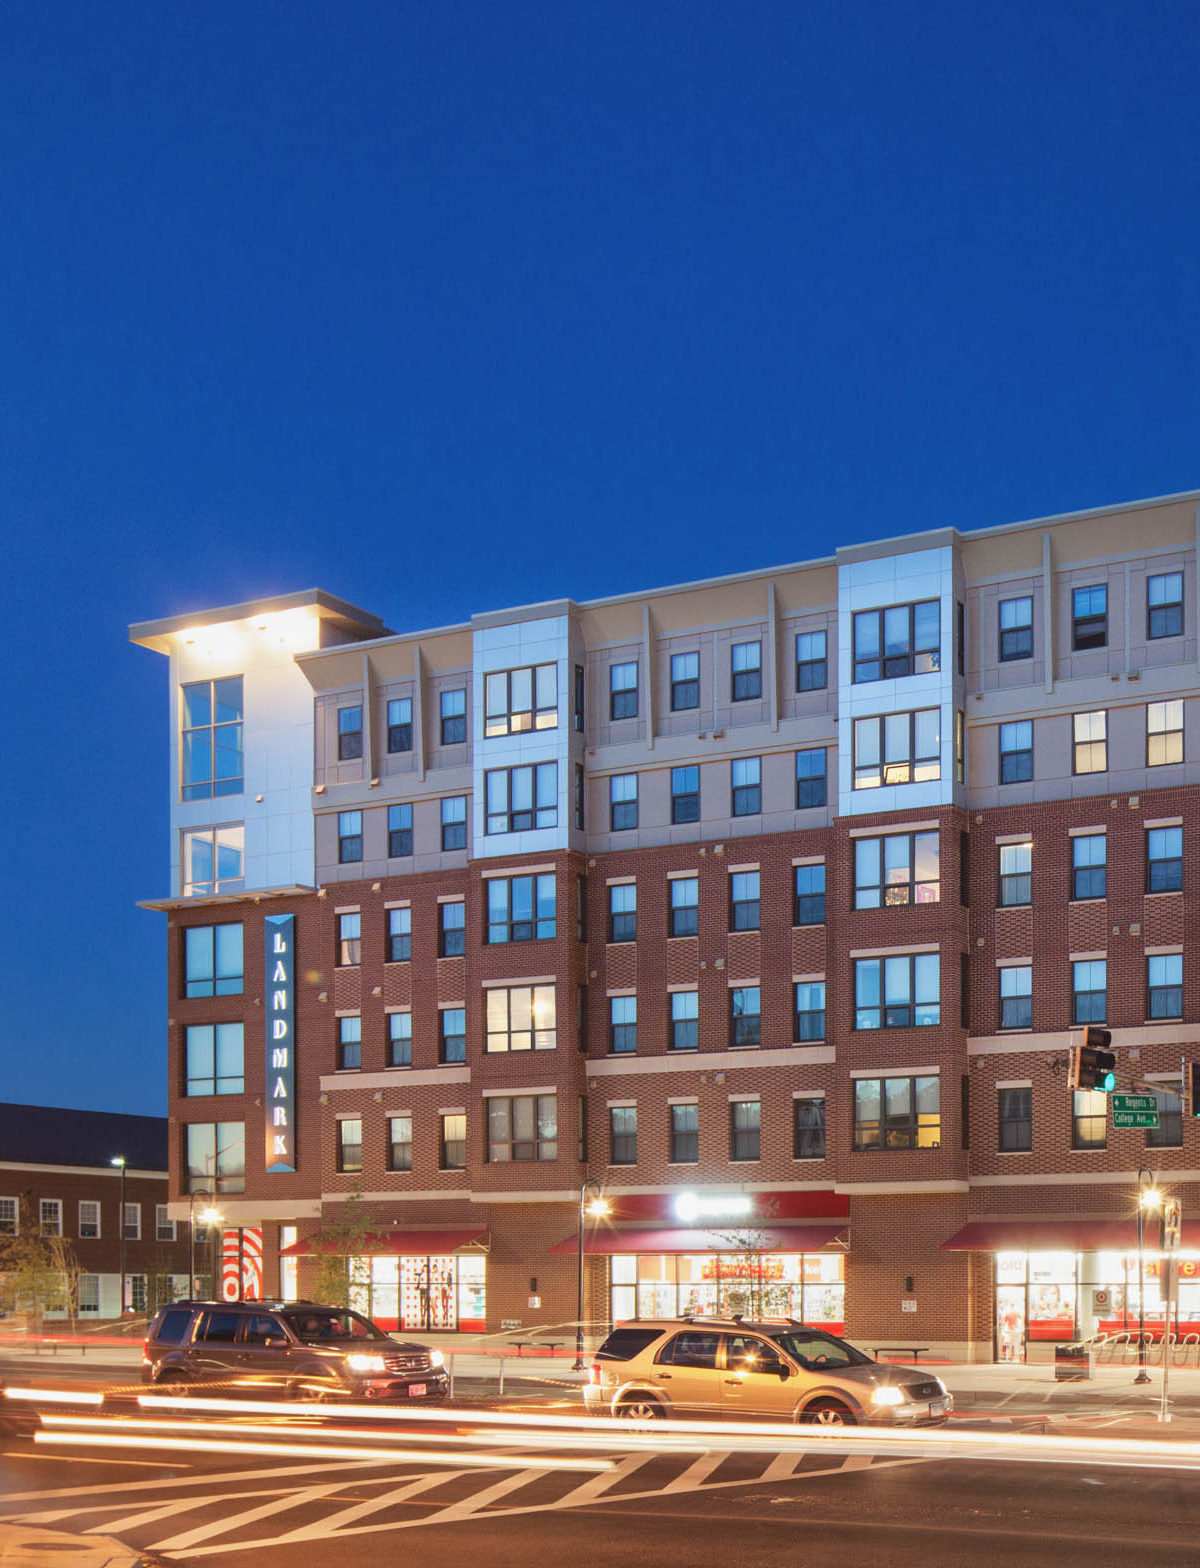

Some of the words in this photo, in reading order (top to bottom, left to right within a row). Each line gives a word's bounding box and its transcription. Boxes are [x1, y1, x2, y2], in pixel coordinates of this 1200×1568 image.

[272, 932, 288, 1155] LANDMARK
[1126, 1096, 1147, 1110] Regents
[1115, 1113, 1134, 1126] College
[1145, 1257, 1195, 1276] stre
